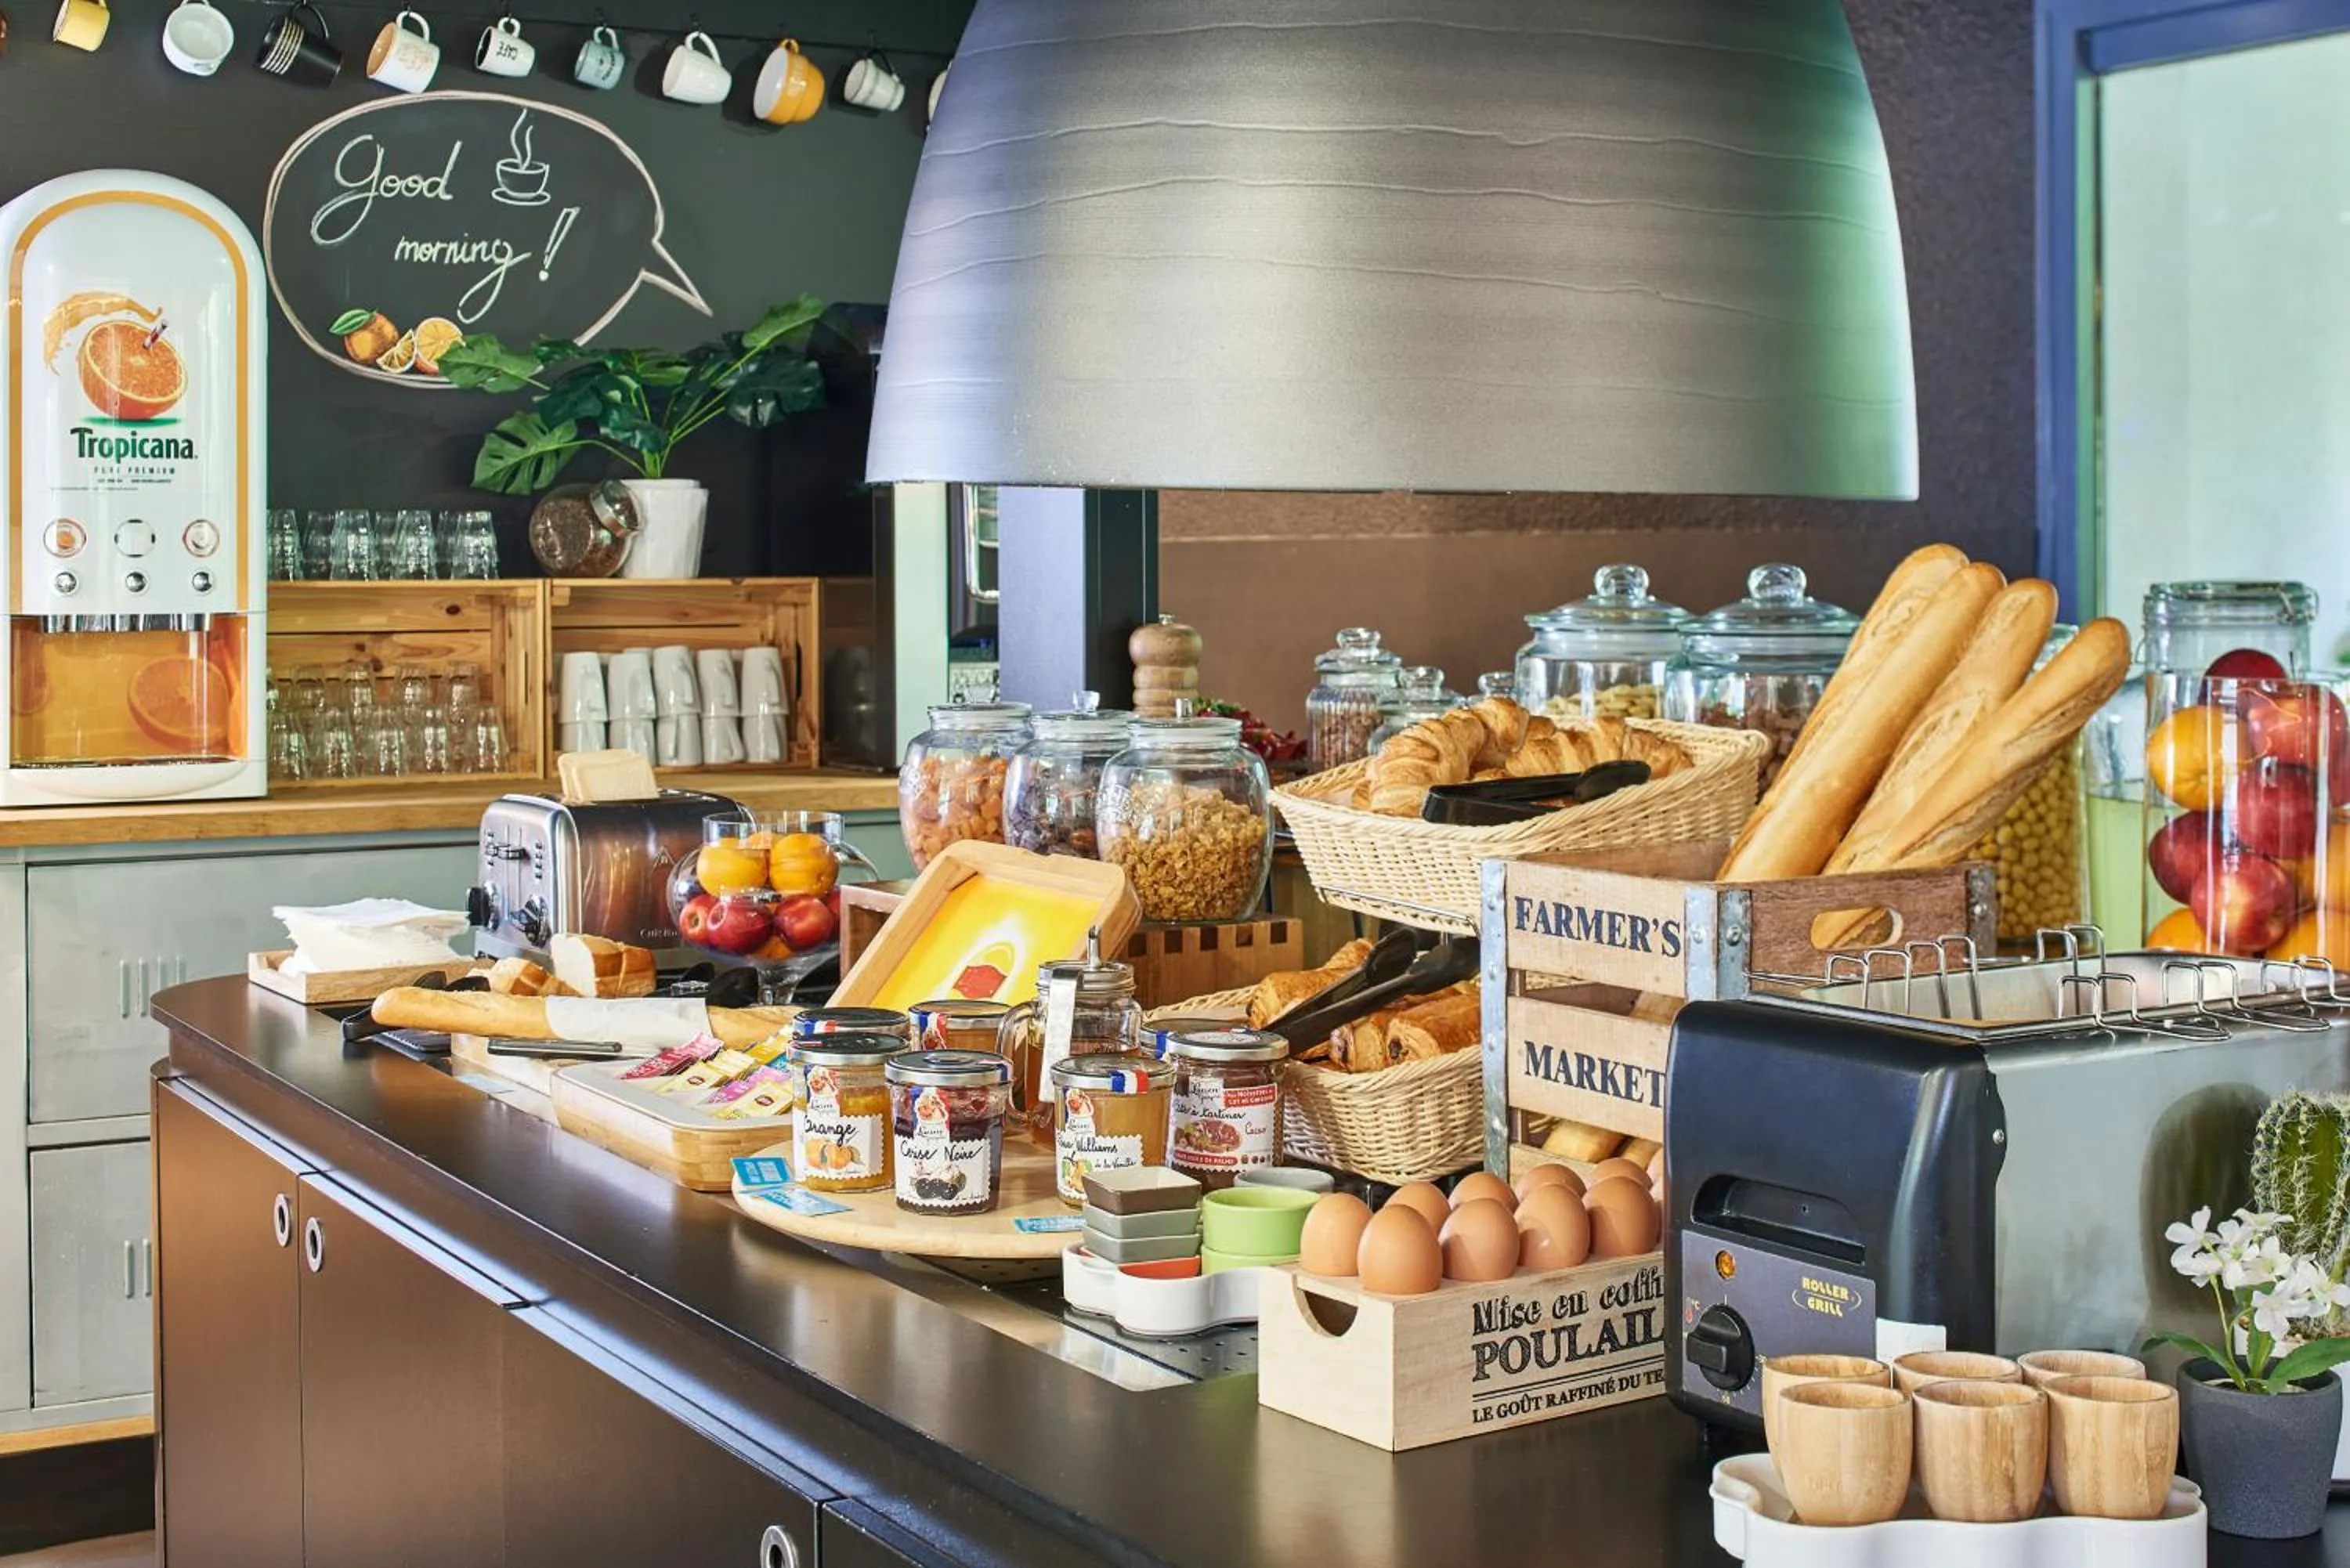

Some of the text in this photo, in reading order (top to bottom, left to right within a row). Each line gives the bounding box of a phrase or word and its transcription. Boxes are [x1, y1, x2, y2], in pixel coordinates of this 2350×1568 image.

[310, 134, 463, 247] Good
[70, 427, 194, 464] Tropicana
[1514, 895, 1683, 958] FARMER'S
[1524, 1040, 1666, 1108] MARKET
[1472, 1295, 1542, 1336] Mise
[1553, 1290, 1589, 1320] en
[1802, 1276, 1849, 1302] ROLLER
[1806, 1296, 1844, 1317] GRILL
[1471, 1306, 1665, 1382] POULAIL
[1472, 1406, 1494, 1423] LE
[1497, 1393, 1542, 1418] GOÛT
[1546, 1375, 1615, 1408] RAFFINÉ
[1618, 1371, 1641, 1392] DU
